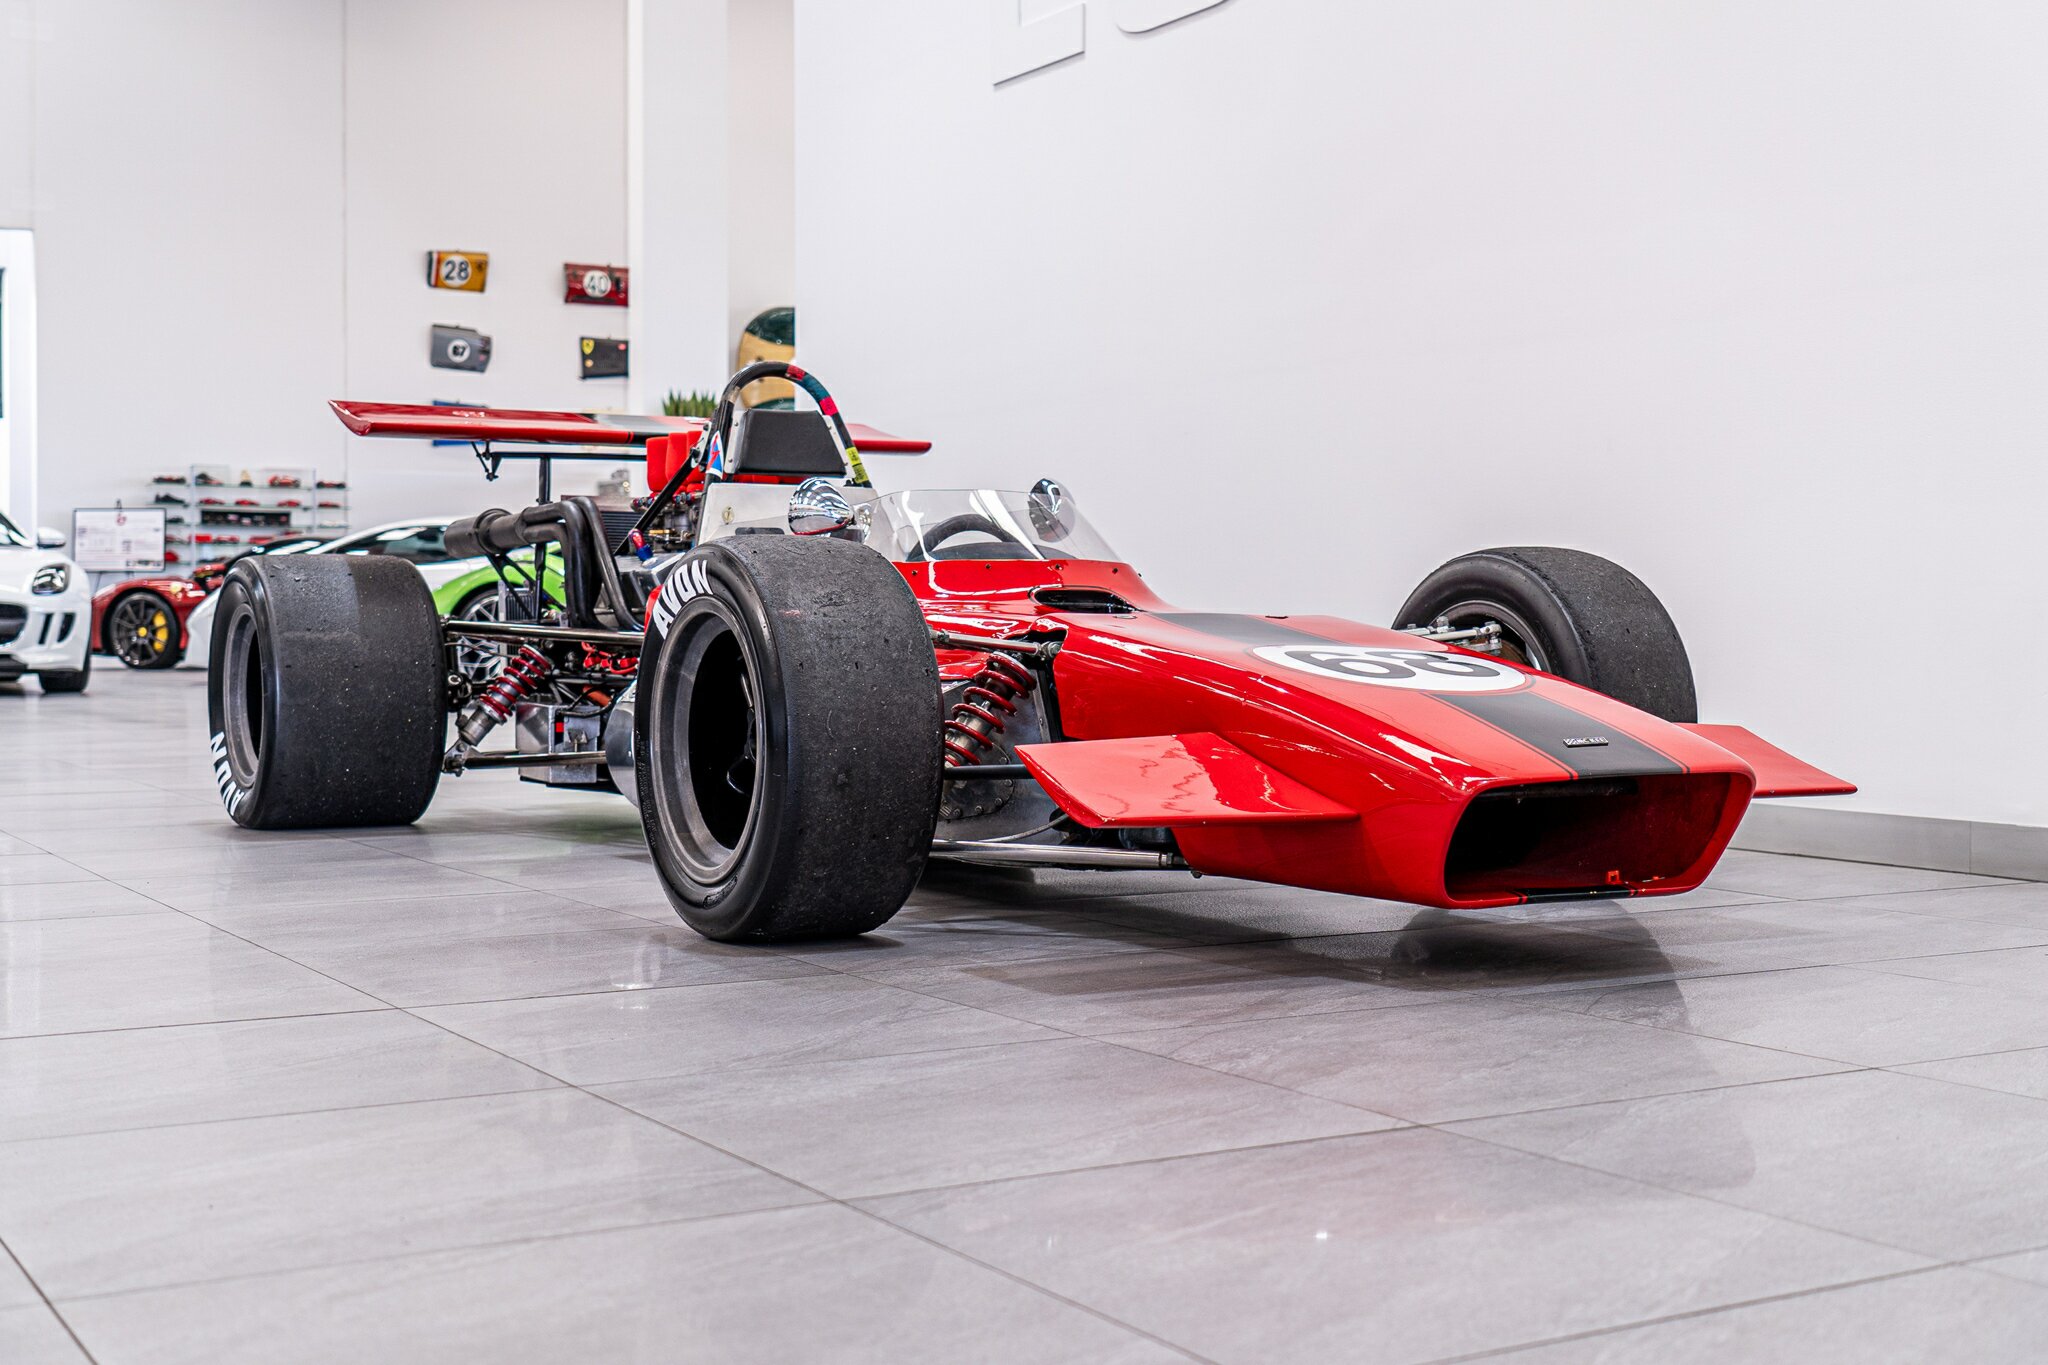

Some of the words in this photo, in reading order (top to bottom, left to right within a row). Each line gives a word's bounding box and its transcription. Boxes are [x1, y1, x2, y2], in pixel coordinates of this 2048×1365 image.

[444, 260, 470, 281] 28
[652, 559, 714, 640] AVON
[1284, 650, 1501, 679] 68
[210, 731, 245, 817] AVON
